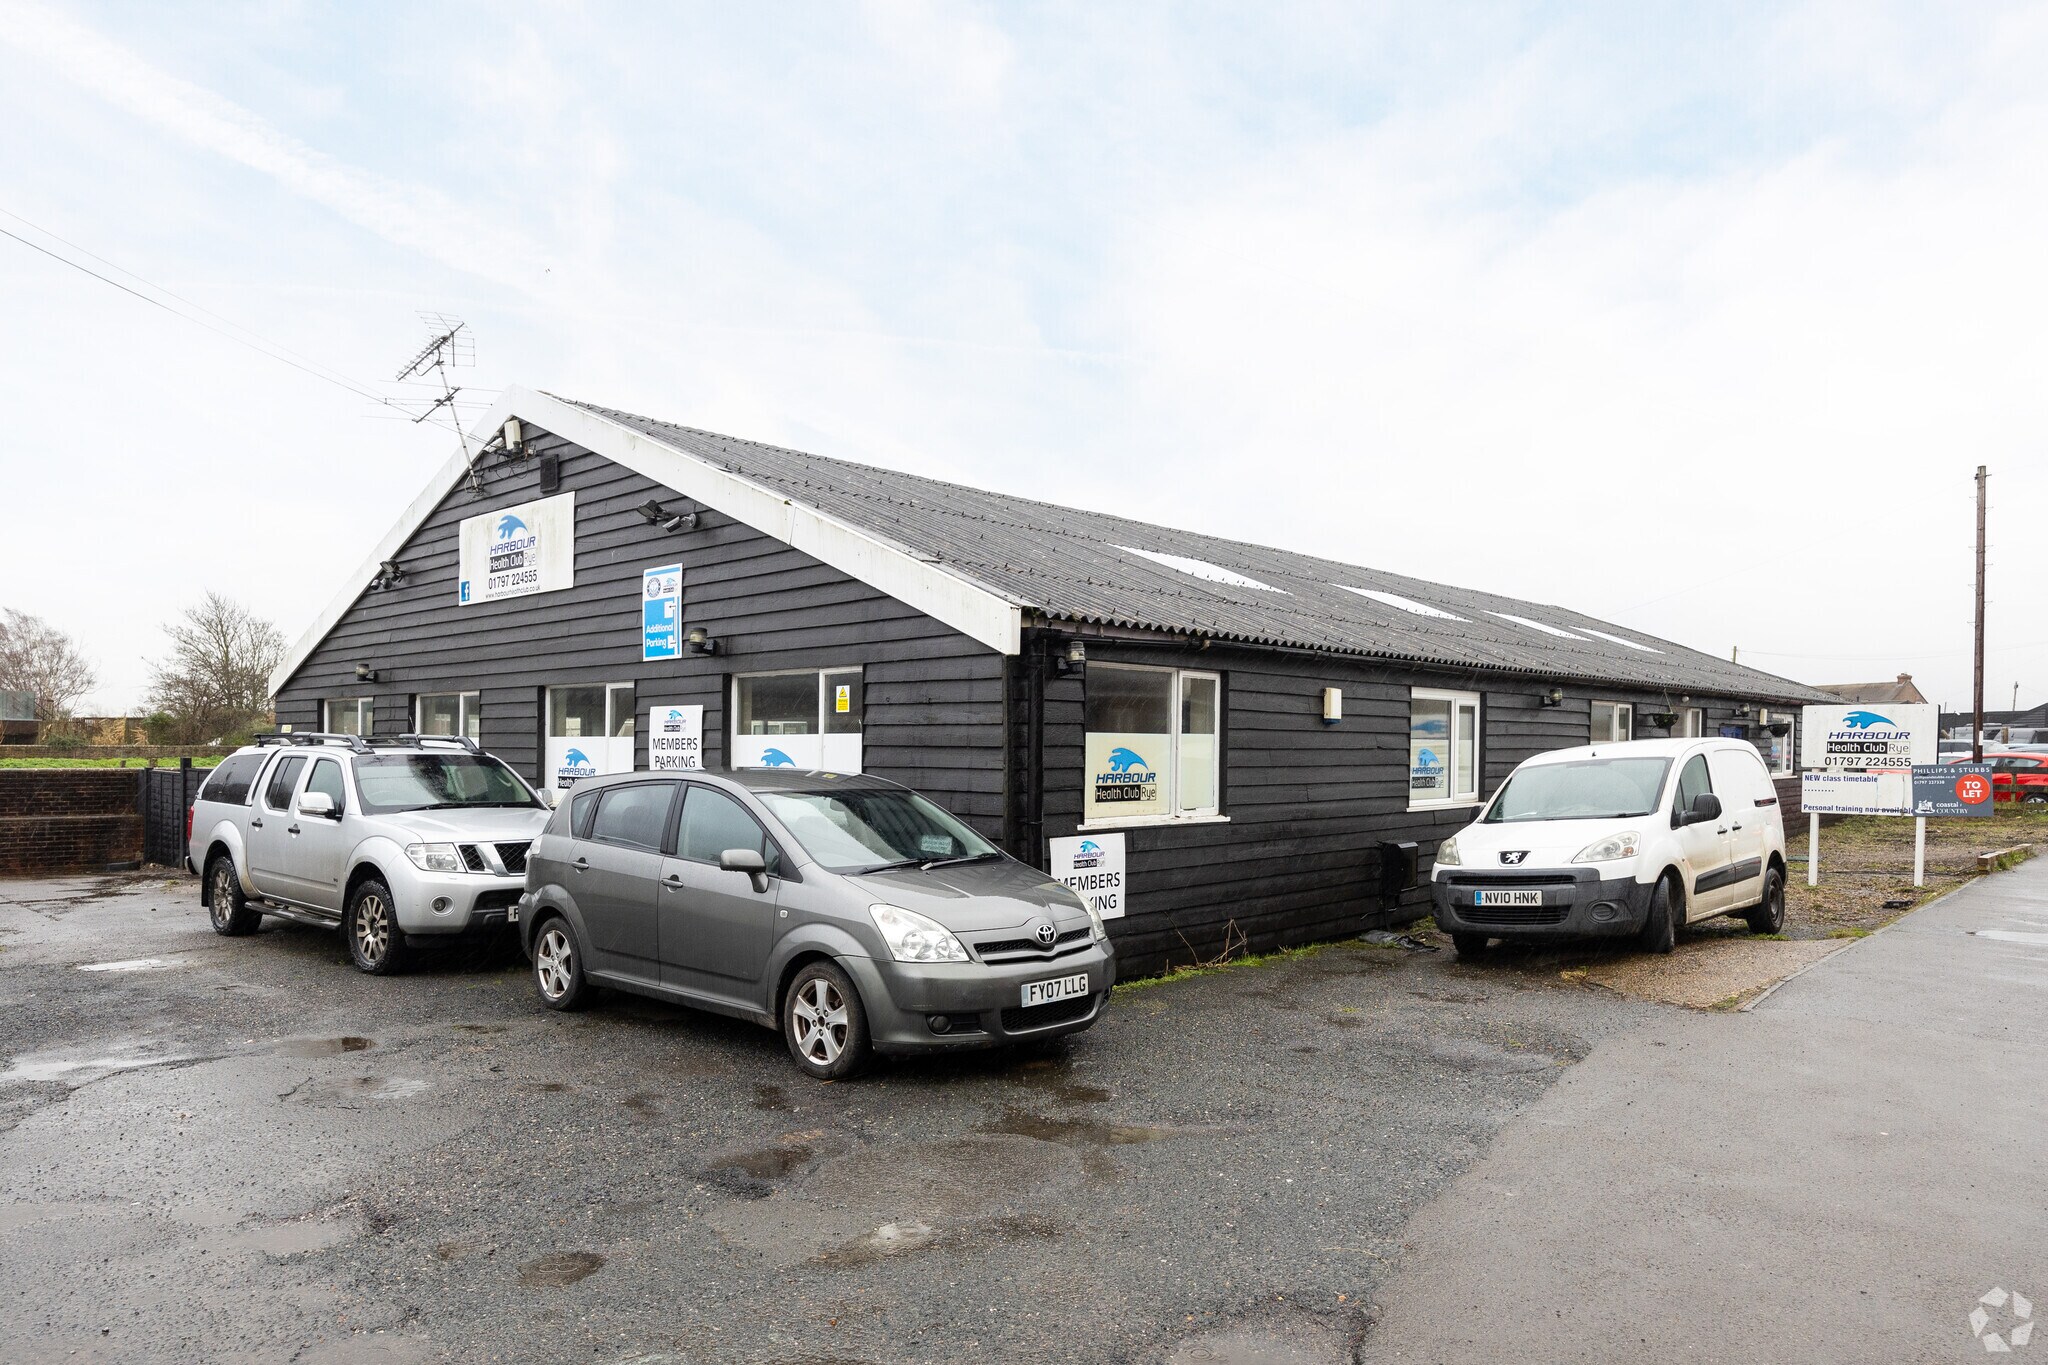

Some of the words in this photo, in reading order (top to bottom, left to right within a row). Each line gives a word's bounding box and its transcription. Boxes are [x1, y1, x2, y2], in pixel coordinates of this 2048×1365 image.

[489, 536, 537, 556] HARBOUR
[490, 556, 510, 571] Health
[510, 553, 523, 567] Club
[488, 575, 510, 590] 01797
[511, 569, 538, 586] 224555
[645, 622, 674, 634] Additional
[646, 637, 667, 650] Parking
[1828, 731, 1911, 740] HARBOUR
[652, 737, 698, 751] MEMBERS
[1827, 742, 1861, 752] Health
[1863, 742, 1886, 753] Club
[1888, 743, 1910, 755] Rye
[654, 755, 696, 769] PARKING
[1824, 756, 1862, 767] 01797
[1865, 756, 1912, 767] 224555
[558, 766, 597, 777] HARBOUR
[1411, 766, 1444, 775] HARBOUR
[1096, 772, 1156, 784] HARBOUR
[1843, 775, 1878, 783] timetable
[1964, 781, 1981, 789] TO
[1095, 786, 1122, 800] Health
[1123, 786, 1140, 799] Club
[1141, 786, 1156, 801] Rye
[1962, 789, 1983, 798] LET
[1835, 804, 1864, 813] training
[1073, 851, 1106, 860] HARBOUR
[1485, 892, 1511, 904] NV10
[1514, 892, 1538, 904] HNK
[1029, 980, 1062, 1002] FY07
[1064, 976, 1087, 995] LLG
